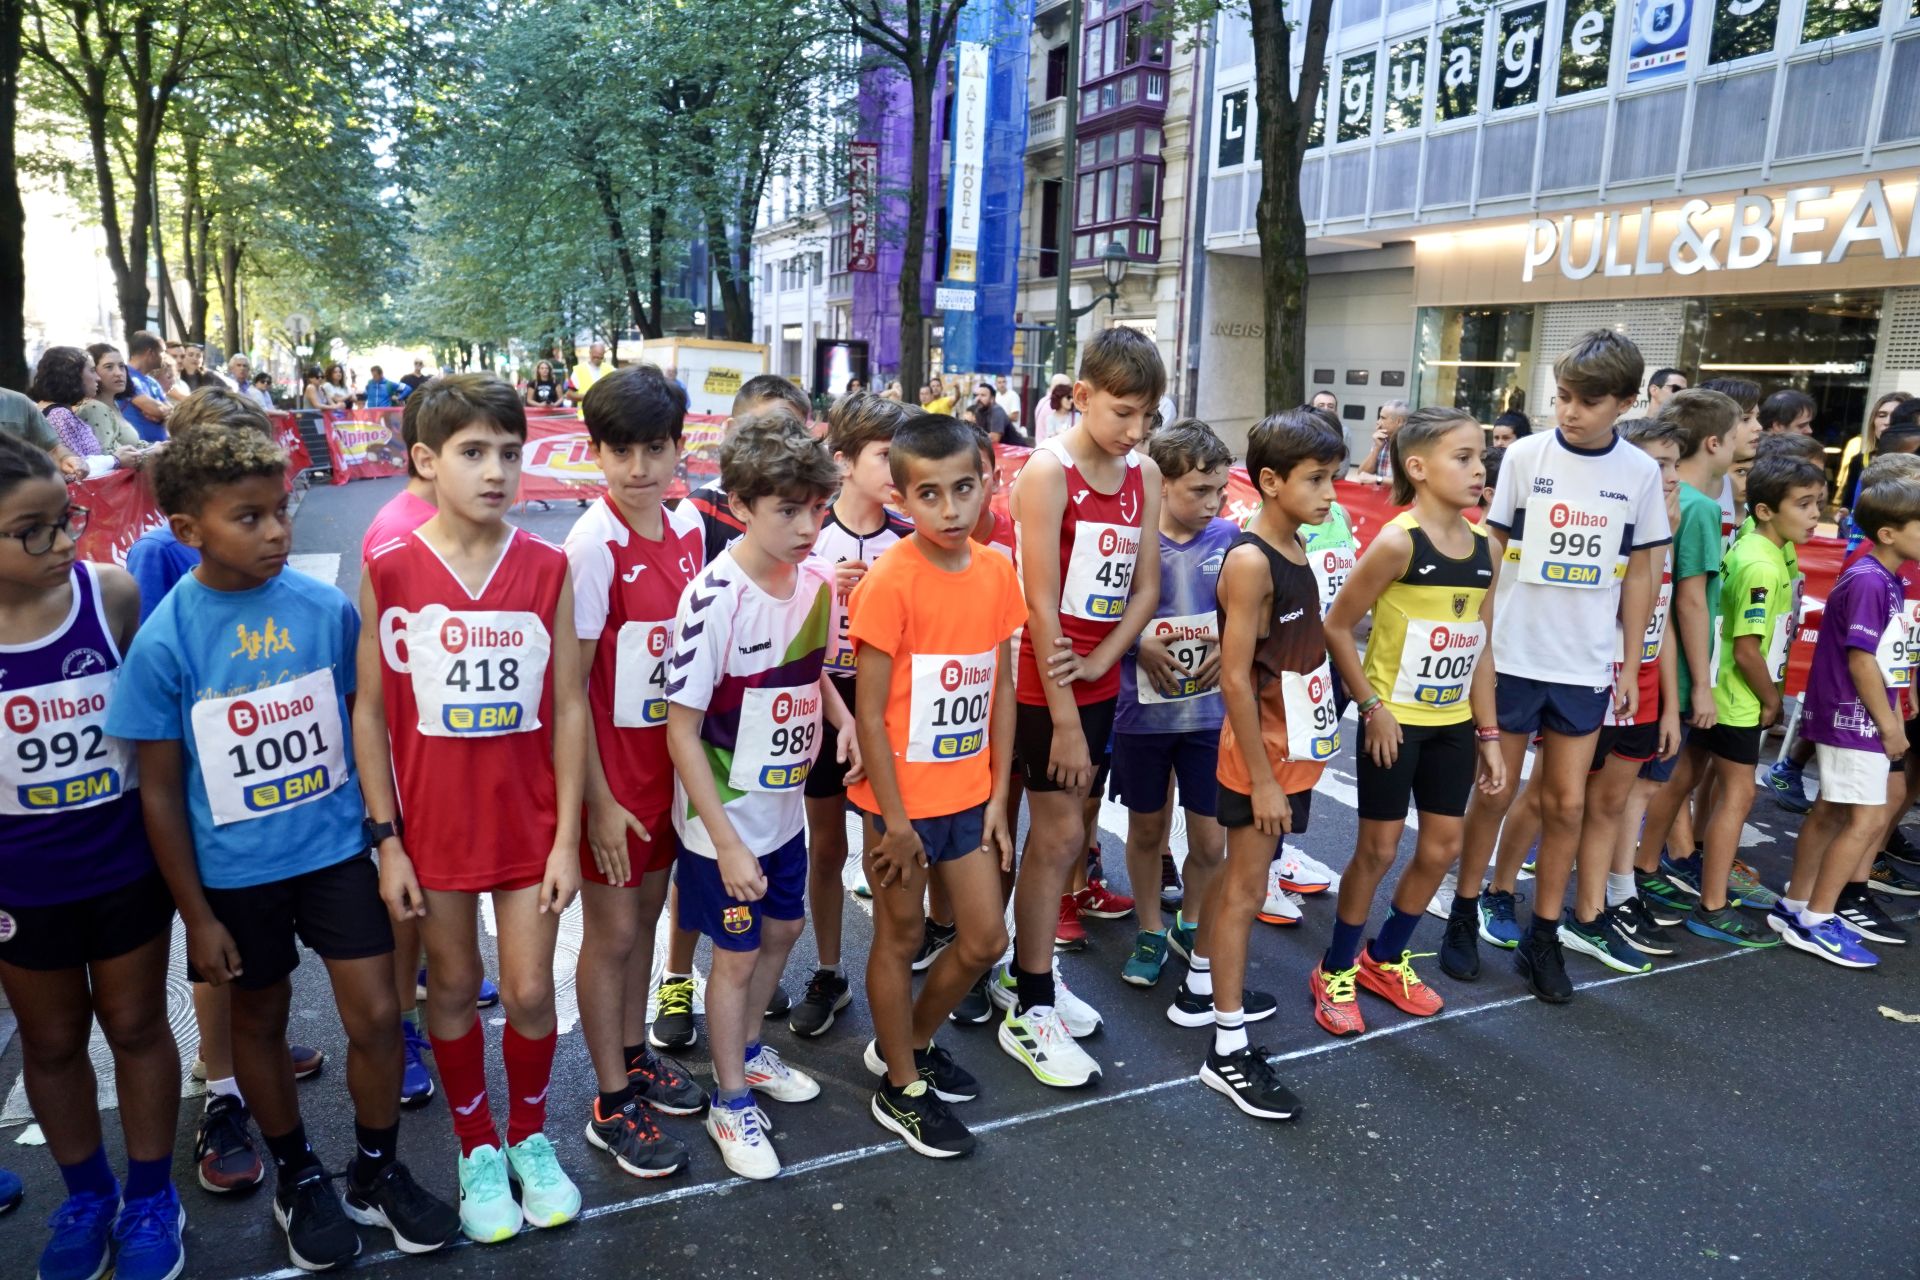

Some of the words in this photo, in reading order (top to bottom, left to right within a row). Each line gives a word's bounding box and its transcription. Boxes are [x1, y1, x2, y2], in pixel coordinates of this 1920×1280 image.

[961, 164, 975, 230] NORTE
[1209, 321, 1265, 337] INBIS
[1532, 485, 1553, 495] 1968
[1549, 503, 1608, 529] Bilbao
[1549, 531, 1602, 558] 996
[1095, 561, 1132, 589] 456
[1567, 566, 1598, 583] BM
[440, 617, 524, 655] Bilbao
[738, 637, 773, 656] hummel
[1430, 626, 1479, 652] Bilbao
[446, 657, 520, 693] 418
[1416, 653, 1475, 680] 1003
[1439, 686, 1463, 703] BM
[5, 694, 105, 734] Bilbao
[228, 695, 315, 737] Bilbao
[478, 705, 519, 728] BM
[931, 690, 990, 727] 1002
[17, 724, 108, 774] 992
[228, 721, 329, 778] 1001
[770, 721, 816, 757] 989
[960, 732, 982, 753] BM
[65, 772, 111, 803] BM
[284, 768, 324, 801] BM
[788, 765, 810, 785] BM
